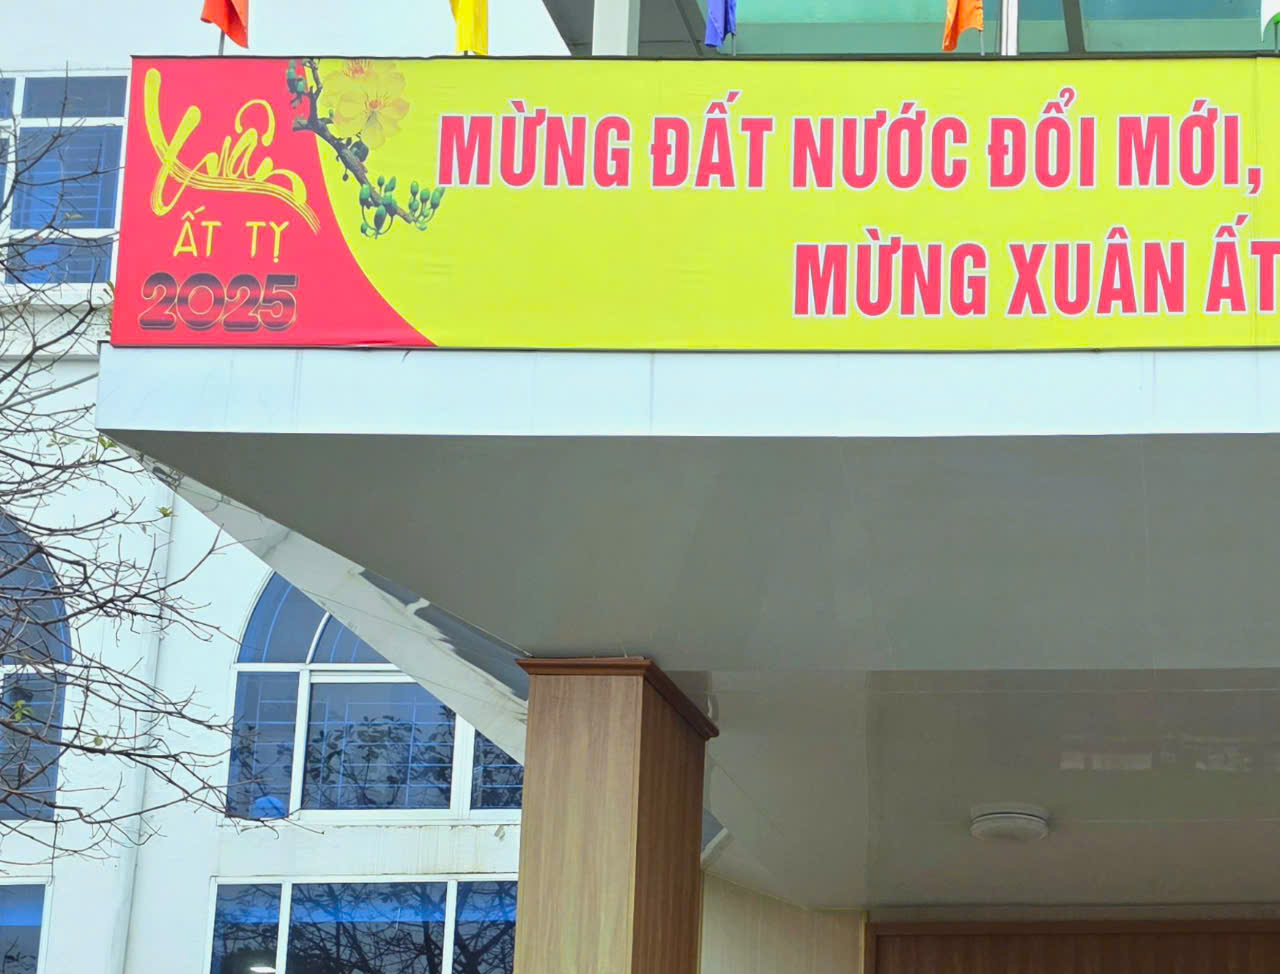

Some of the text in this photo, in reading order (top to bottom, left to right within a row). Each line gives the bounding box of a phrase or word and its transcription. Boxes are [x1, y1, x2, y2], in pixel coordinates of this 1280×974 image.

[437, 100, 632, 188] MỪNG
[650, 91, 773, 188] ĐẤT
[793, 102, 969, 189] NƯỚC
[987, 88, 1096, 189] ĐỔI
[1118, 99, 1263, 194] MỚI,
[173, 206, 289, 263] ẤT TỴ
[793, 228, 988, 317] MỪNG
[1007, 226, 1186, 316] XUÂN
[138, 271, 298, 332] 2025
